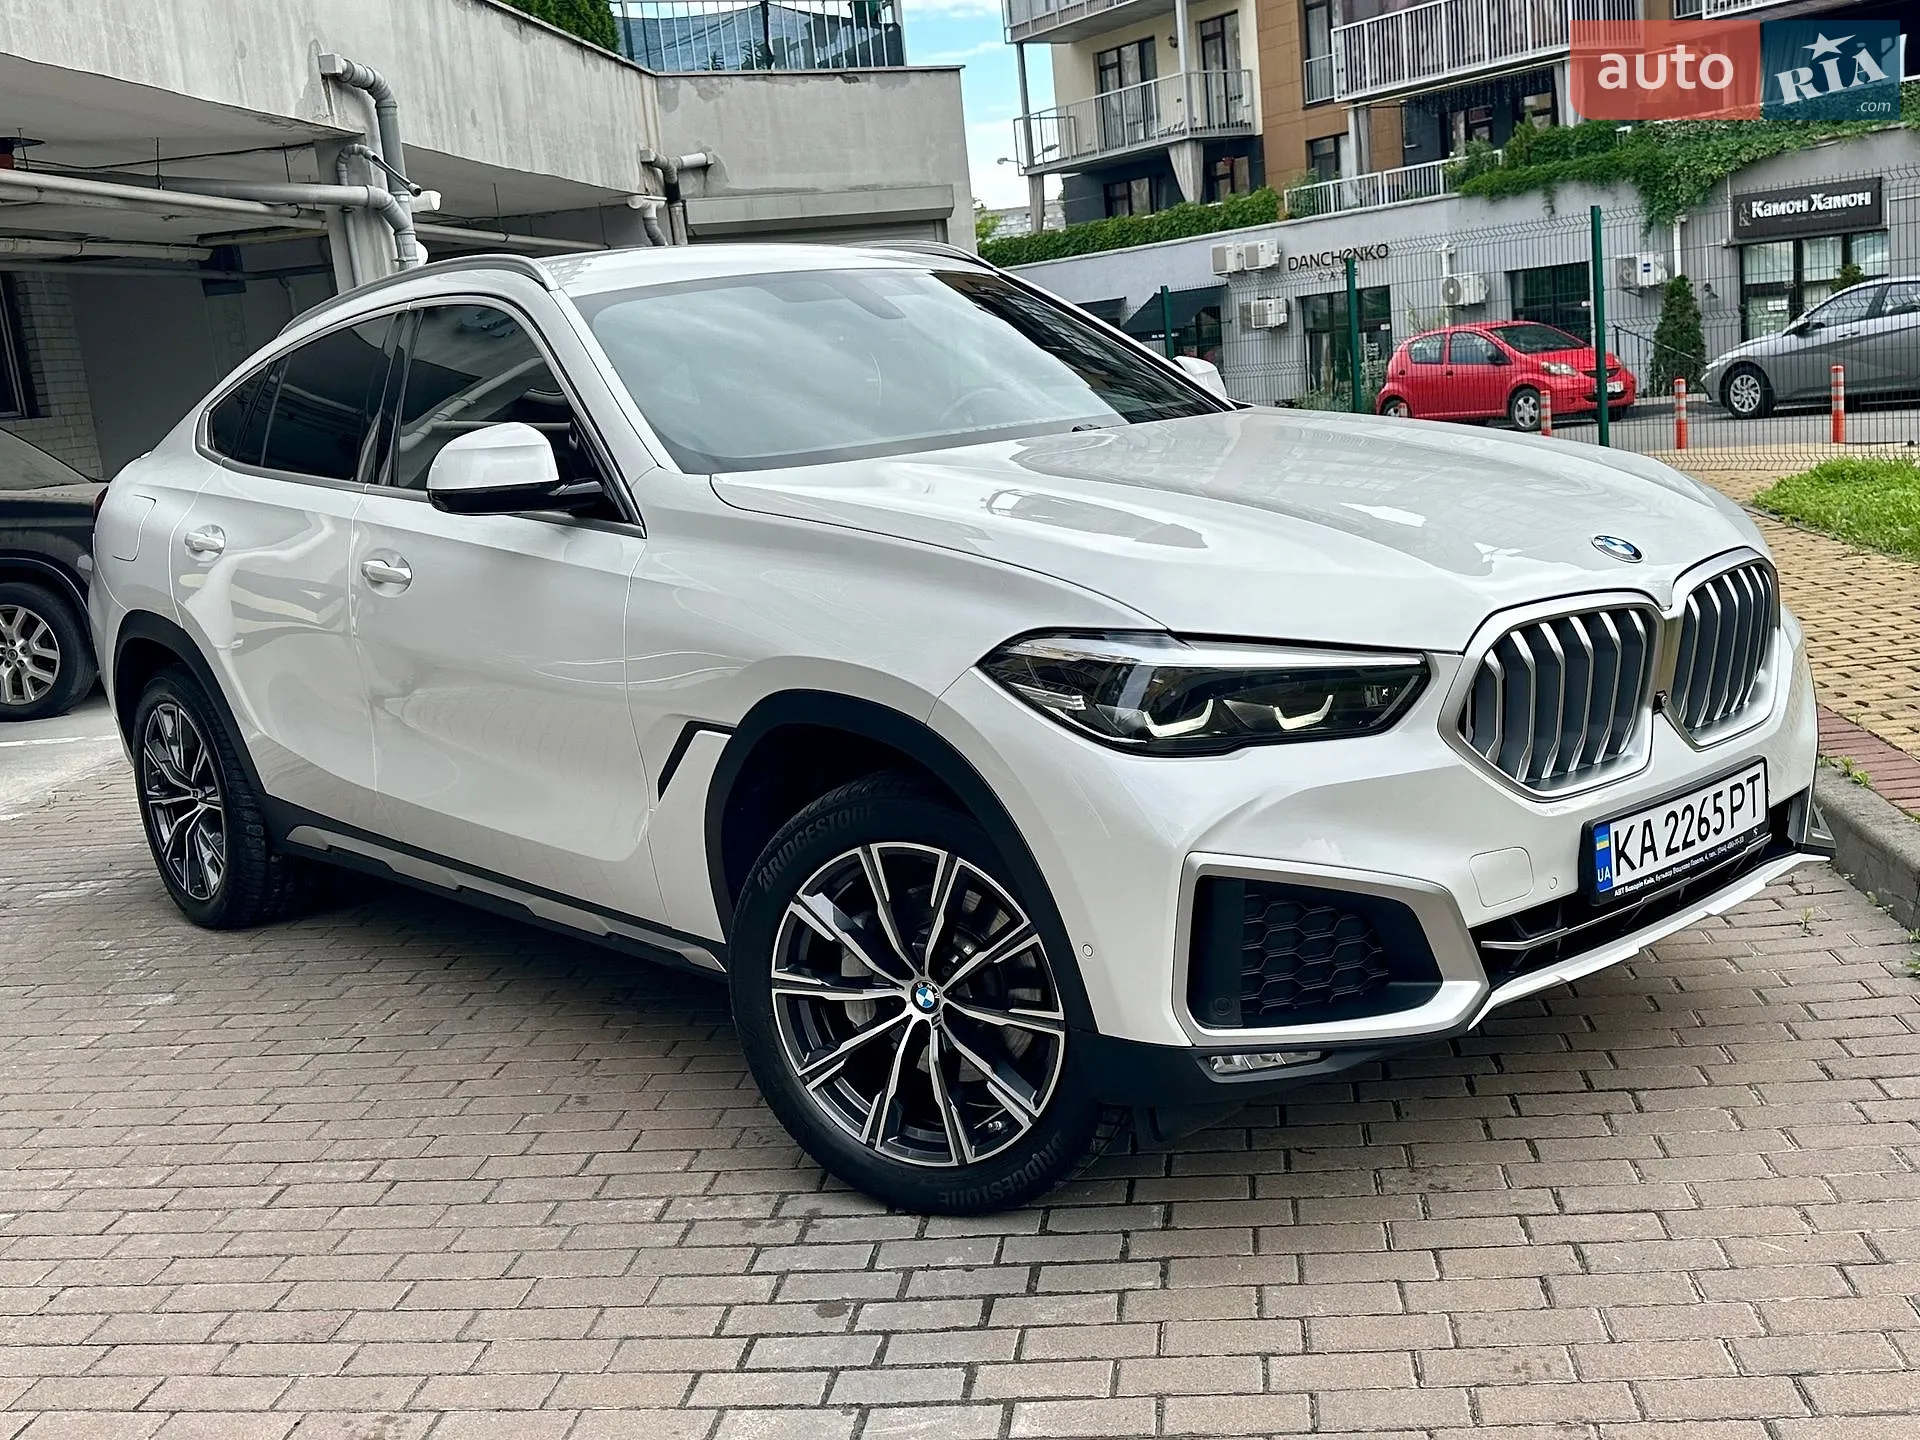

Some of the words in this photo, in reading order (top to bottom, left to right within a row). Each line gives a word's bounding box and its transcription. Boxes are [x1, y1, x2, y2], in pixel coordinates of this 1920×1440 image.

[1751, 200, 1809, 218] Камон
[1810, 191, 1872, 212] Хамон
[1597, 865, 1612, 883] UA
